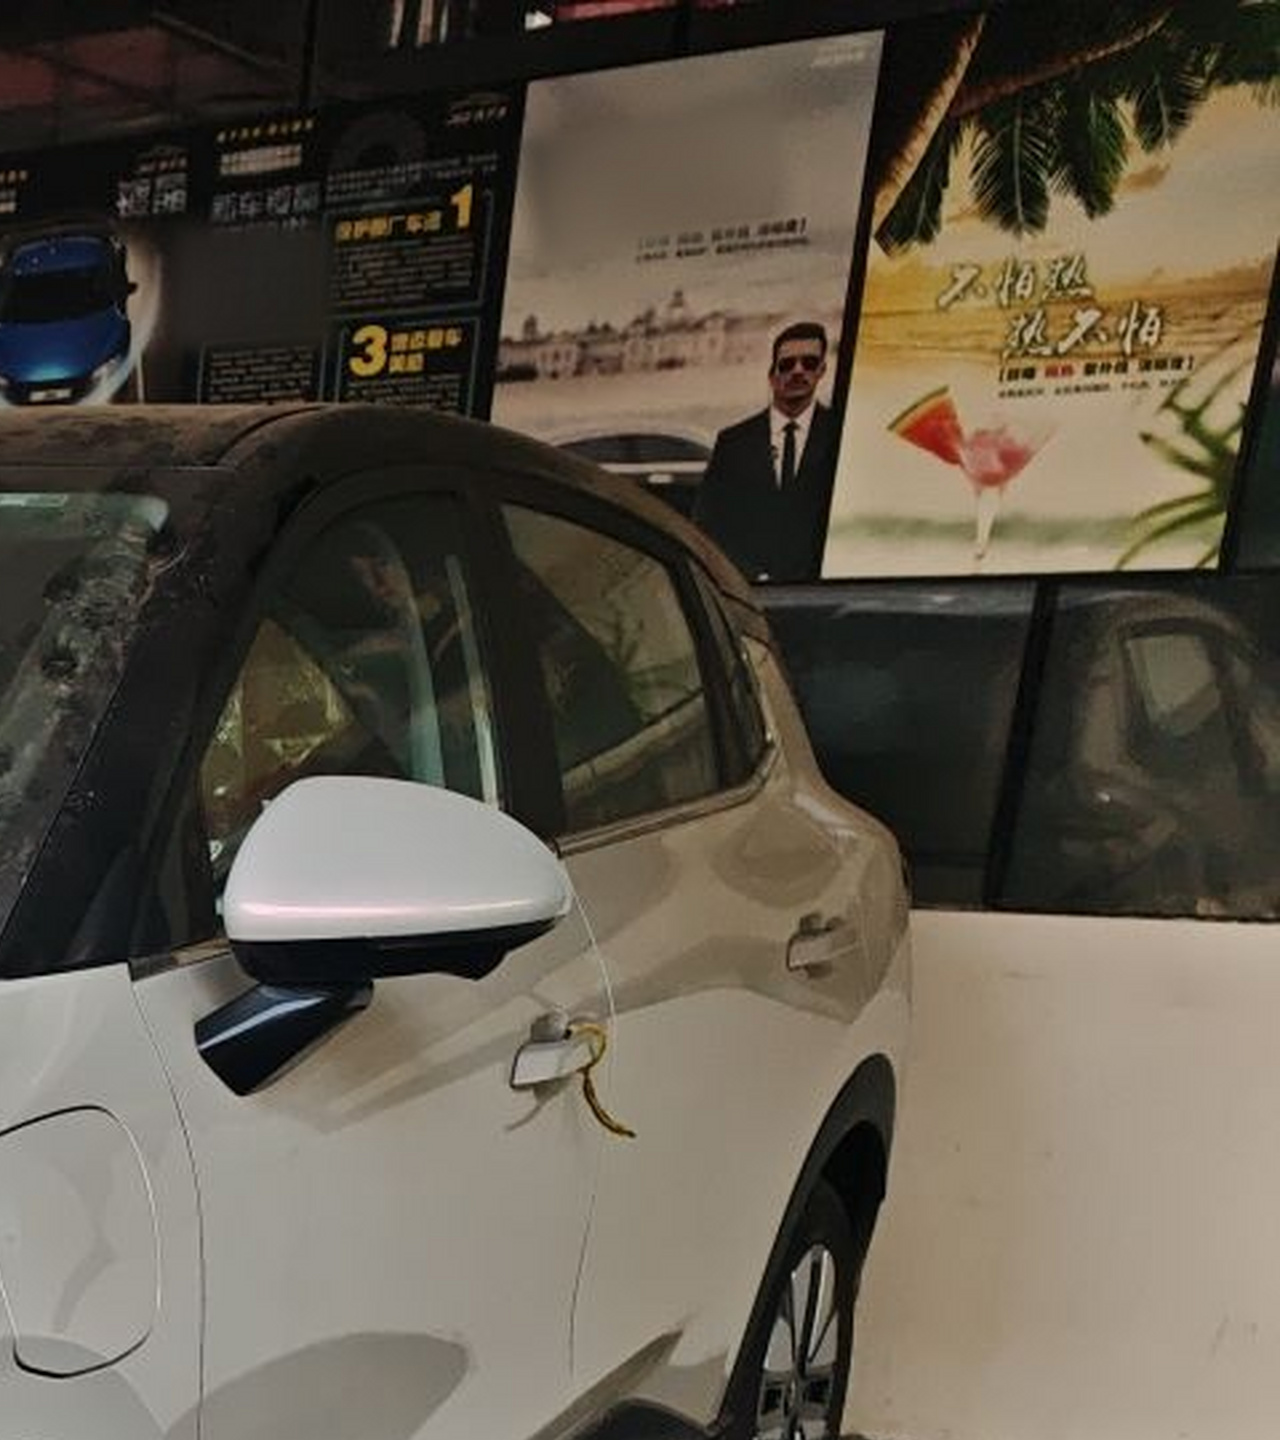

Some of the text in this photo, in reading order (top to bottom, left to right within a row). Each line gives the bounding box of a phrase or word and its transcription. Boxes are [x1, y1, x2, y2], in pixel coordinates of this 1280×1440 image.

[450, 184, 474, 229] 1
[937, 255, 1093, 310] 不怕热
[349, 325, 388, 377] 3
[1003, 300, 1163, 359] 热不怕
